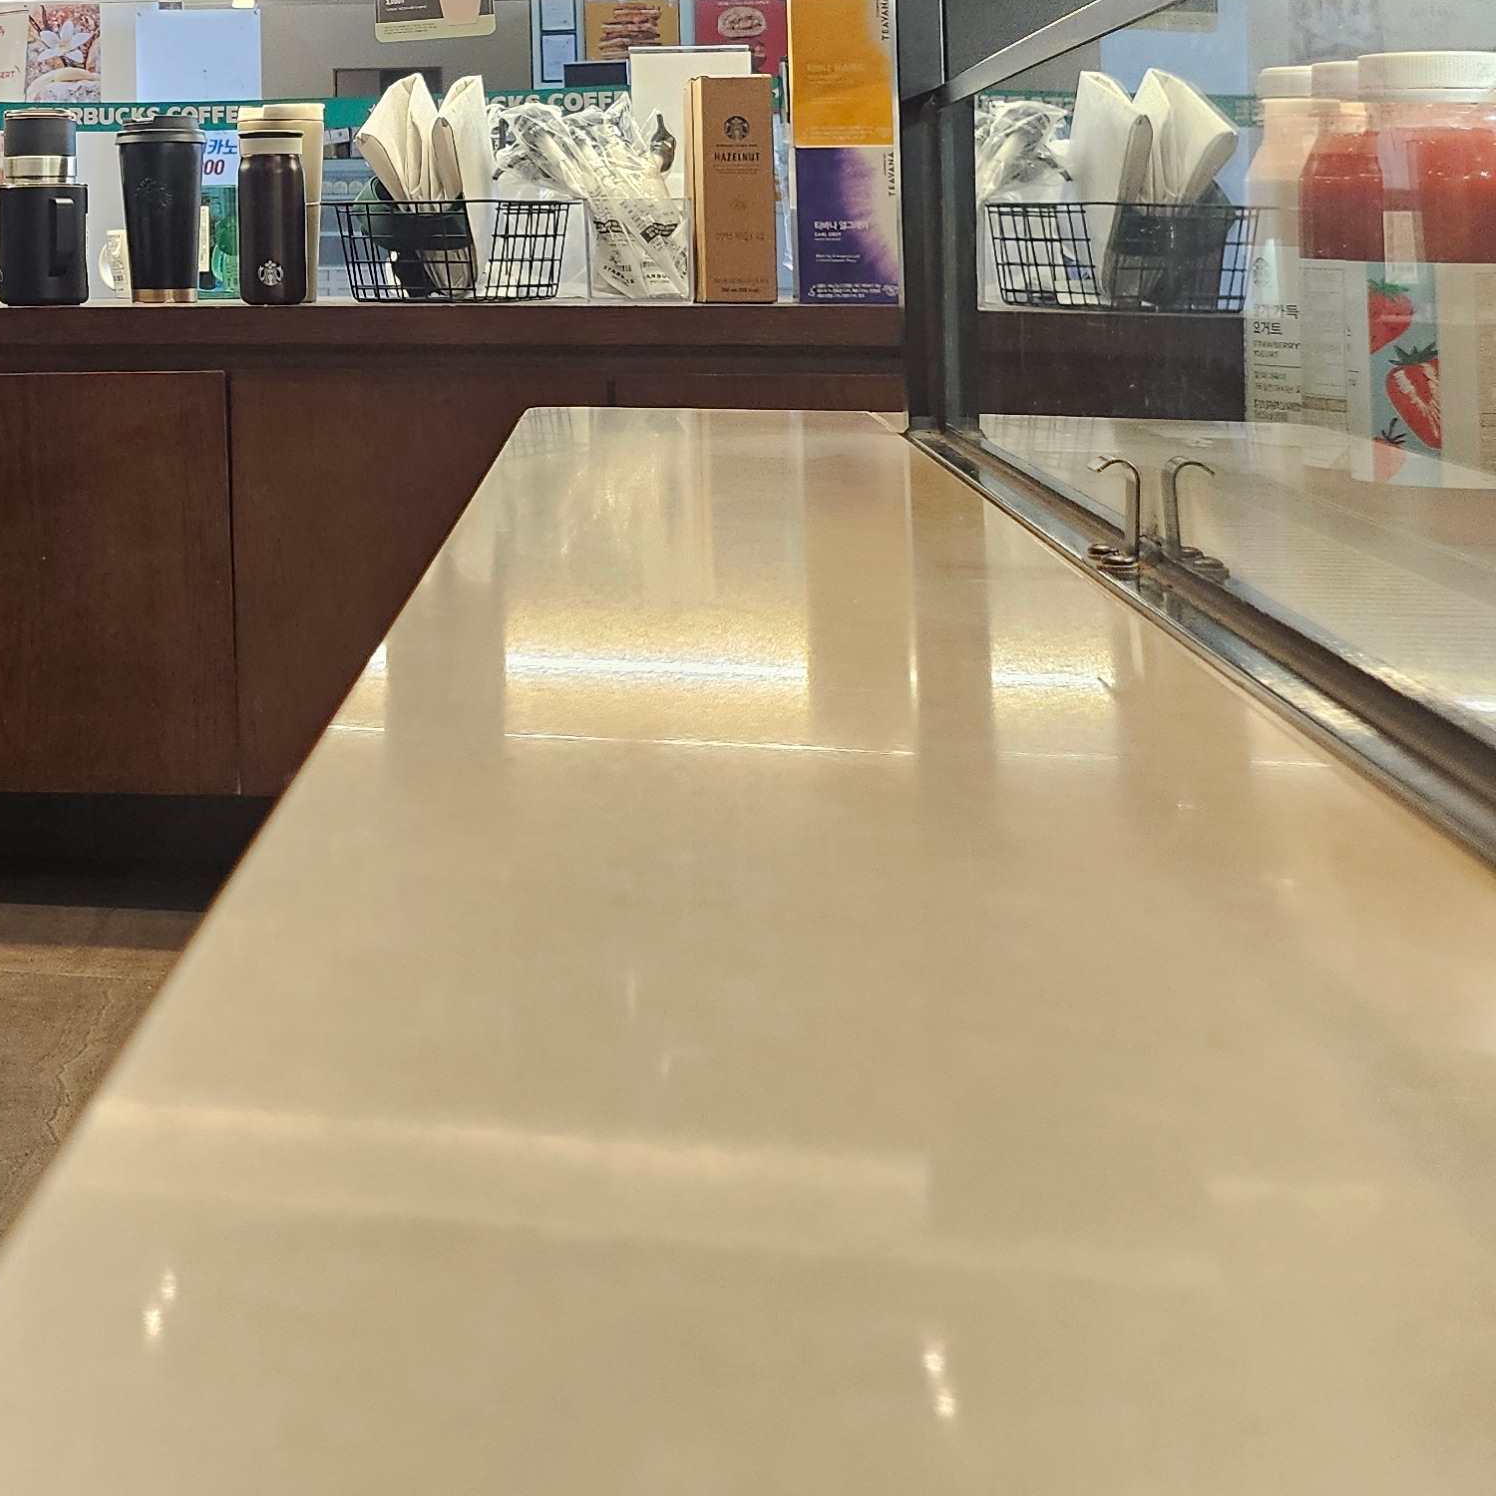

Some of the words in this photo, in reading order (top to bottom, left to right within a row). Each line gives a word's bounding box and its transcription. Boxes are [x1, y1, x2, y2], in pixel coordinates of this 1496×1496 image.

[713, 151, 761, 162] HAZELNUT
[887, 152, 896, 197] TEAVANA
[1272, 304, 1300, 319] 가득
